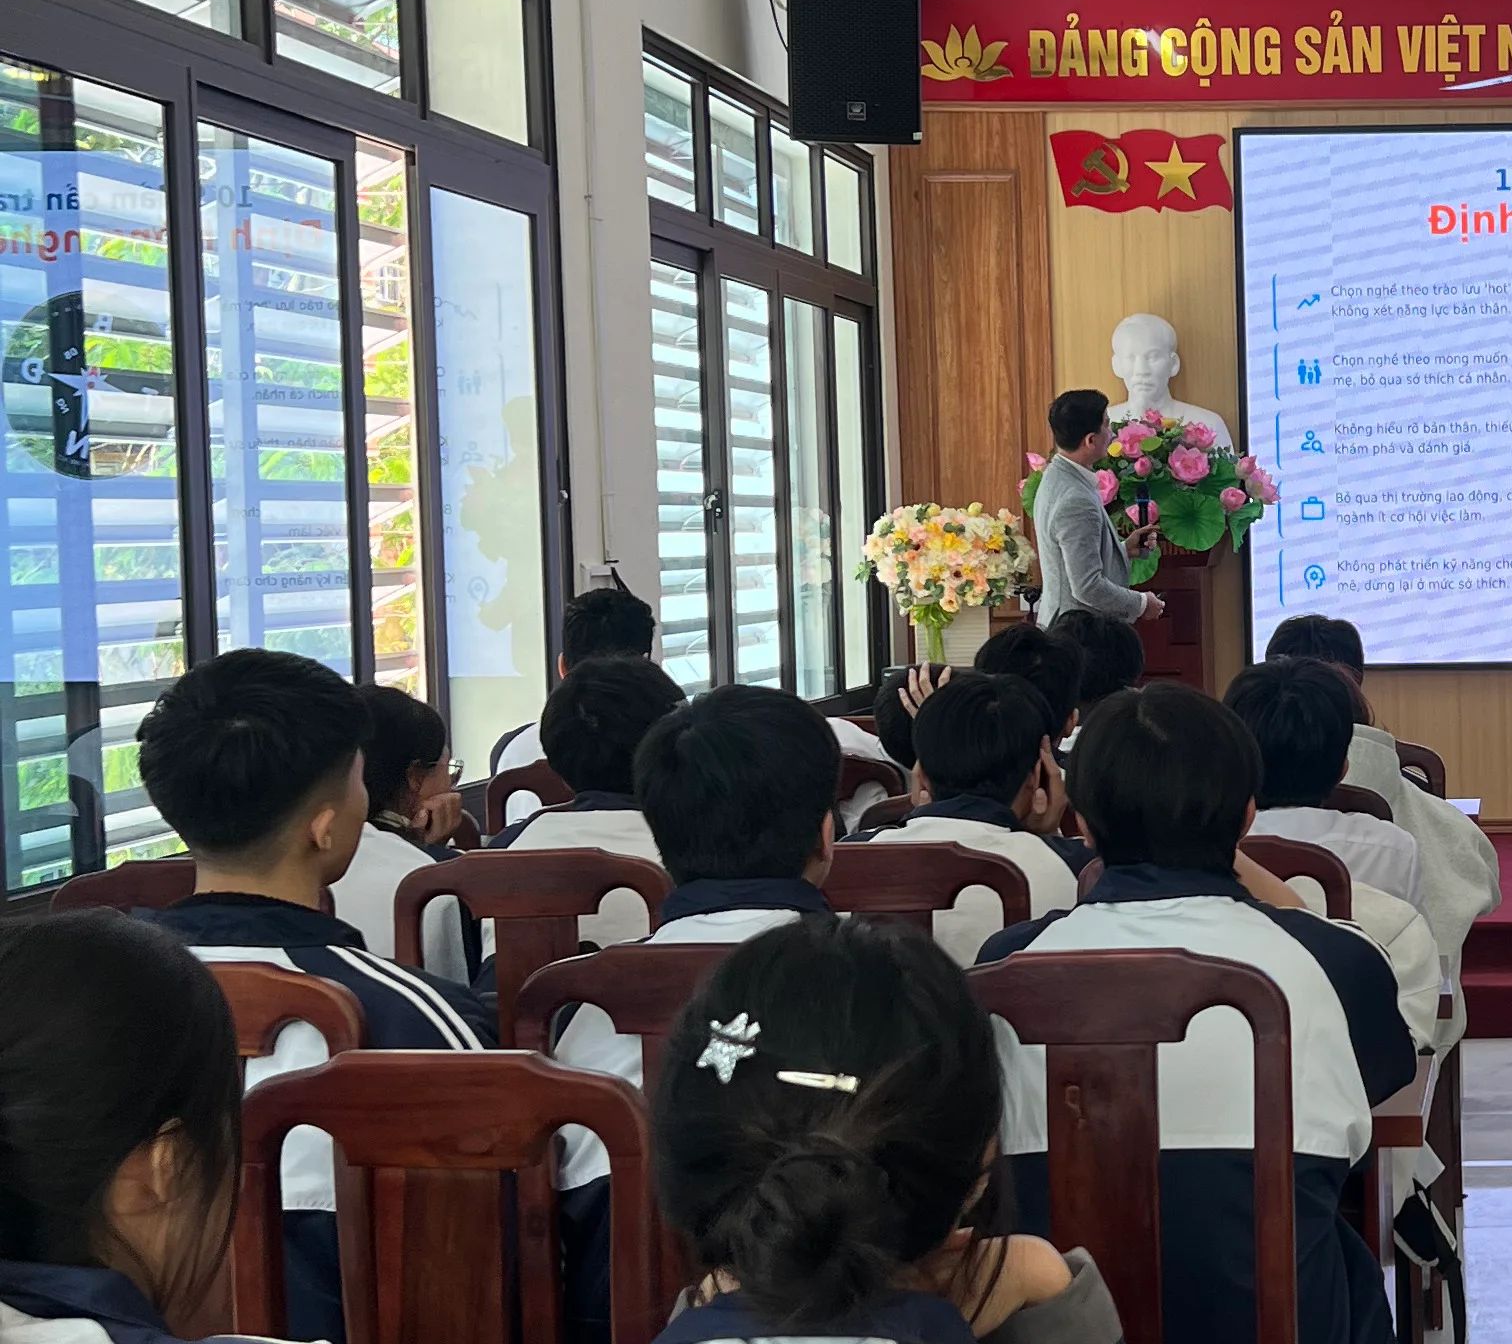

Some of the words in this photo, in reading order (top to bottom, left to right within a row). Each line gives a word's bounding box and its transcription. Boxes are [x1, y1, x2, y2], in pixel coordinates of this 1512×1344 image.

[1028, 13, 1148, 78] ĐẢNG
[1160, 18, 1281, 87] CỘNG
[1295, 10, 1381, 76] SẢN
[1397, 14, 1485, 82] VIỆT
[1330, 284, 1362, 299] Chọn
[1366, 281, 1397, 299] nghề
[1400, 283, 1428, 295] theo
[1432, 282, 1457, 294] trào
[1462, 282, 1480, 294] lưu
[1331, 304, 1369, 320] không
[1373, 303, 1394, 316] xét
[1396, 303, 1426, 319] năng
[1430, 303, 1449, 317] lực
[1452, 302, 1476, 314] bản
[1332, 353, 1364, 368] Chọn
[1368, 350, 1398, 368] nghề
[1402, 352, 1430, 364] theo
[1434, 355, 1468, 367] mong
[1472, 349, 1508, 363] muốn
[1360, 373, 1375, 385] bỏ
[1378, 376, 1402, 388] qua
[1406, 372, 1420, 385] sở
[1423, 372, 1454, 384] thích
[1458, 372, 1472, 384] cá
[1334, 422, 1372, 438] Không
[1376, 419, 1402, 434] hiểu
[1407, 421, 1419, 433] rõ
[1423, 421, 1445, 433] bản
[1334, 442, 1368, 454] khám
[1372, 441, 1395, 457] phá
[1398, 441, 1414, 454] và
[1417, 441, 1448, 453] đánh
[1335, 491, 1351, 503] Bỏ
[1356, 494, 1377, 506] qua
[1382, 491, 1399, 505] thị
[1401, 490, 1442, 506] trường
[1446, 490, 1464, 502] lao
[1336, 511, 1374, 527] ngành
[1390, 513, 1404, 522] cơ
[1408, 509, 1426, 524] hội
[1430, 509, 1455, 524] việc
[1337, 559, 1374, 575] Không
[1379, 558, 1407, 574] phát
[1410, 556, 1440, 570] triển
[1442, 557, 1457, 573] kỹ
[1462, 557, 1491, 573] năng
[1399, 578, 1413, 592] lại
[1416, 577, 1426, 590] ở
[1428, 577, 1454, 589] mức
[1458, 576, 1472, 589] sở
